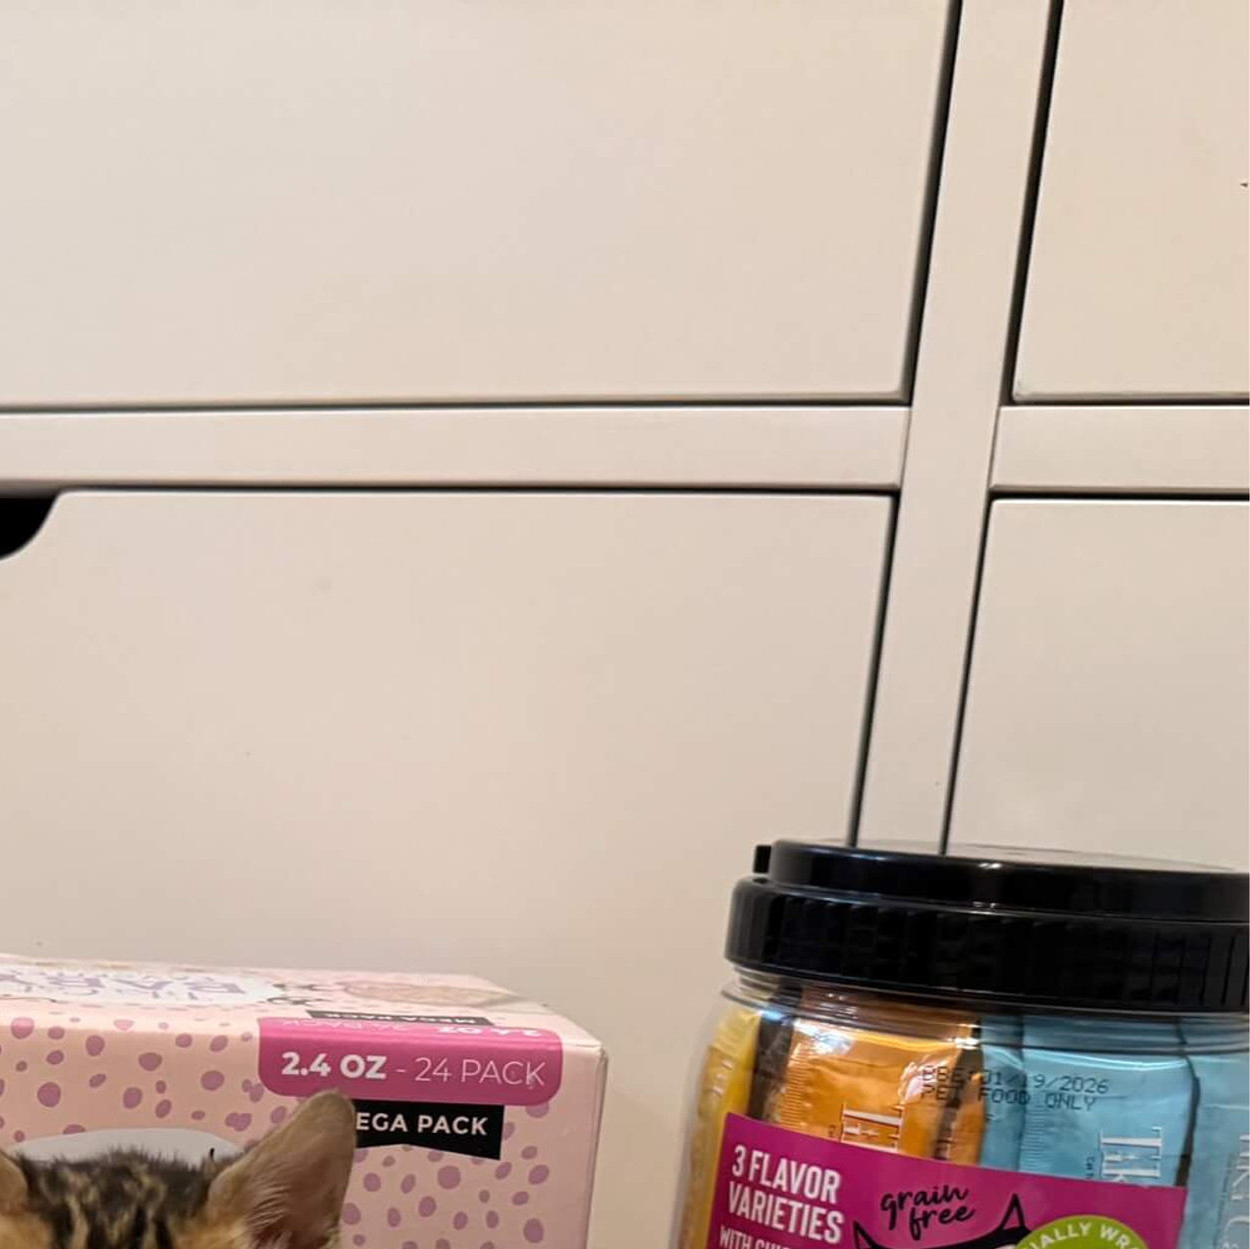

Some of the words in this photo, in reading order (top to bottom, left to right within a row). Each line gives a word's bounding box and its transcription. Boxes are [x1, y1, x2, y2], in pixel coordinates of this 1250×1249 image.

[281, 1051, 332, 1078] 2.4
[340, 1054, 387, 1080] OZ
[414, 1057, 453, 1083] 24
[461, 1059, 546, 1087] PACK
[979, 1087, 1031, 1105] FOOD
[1044, 1093, 1096, 1112] ONLY
[355, 1111, 408, 1134] EGA
[418, 1115, 489, 1137] PACK
[732, 1144, 746, 1178] 3
[748, 1149, 841, 1205] FLAVOR
[728, 1180, 845, 1245] VARIETIES
[880, 1185, 970, 1232] grain
[909, 1206, 976, 1242] free
